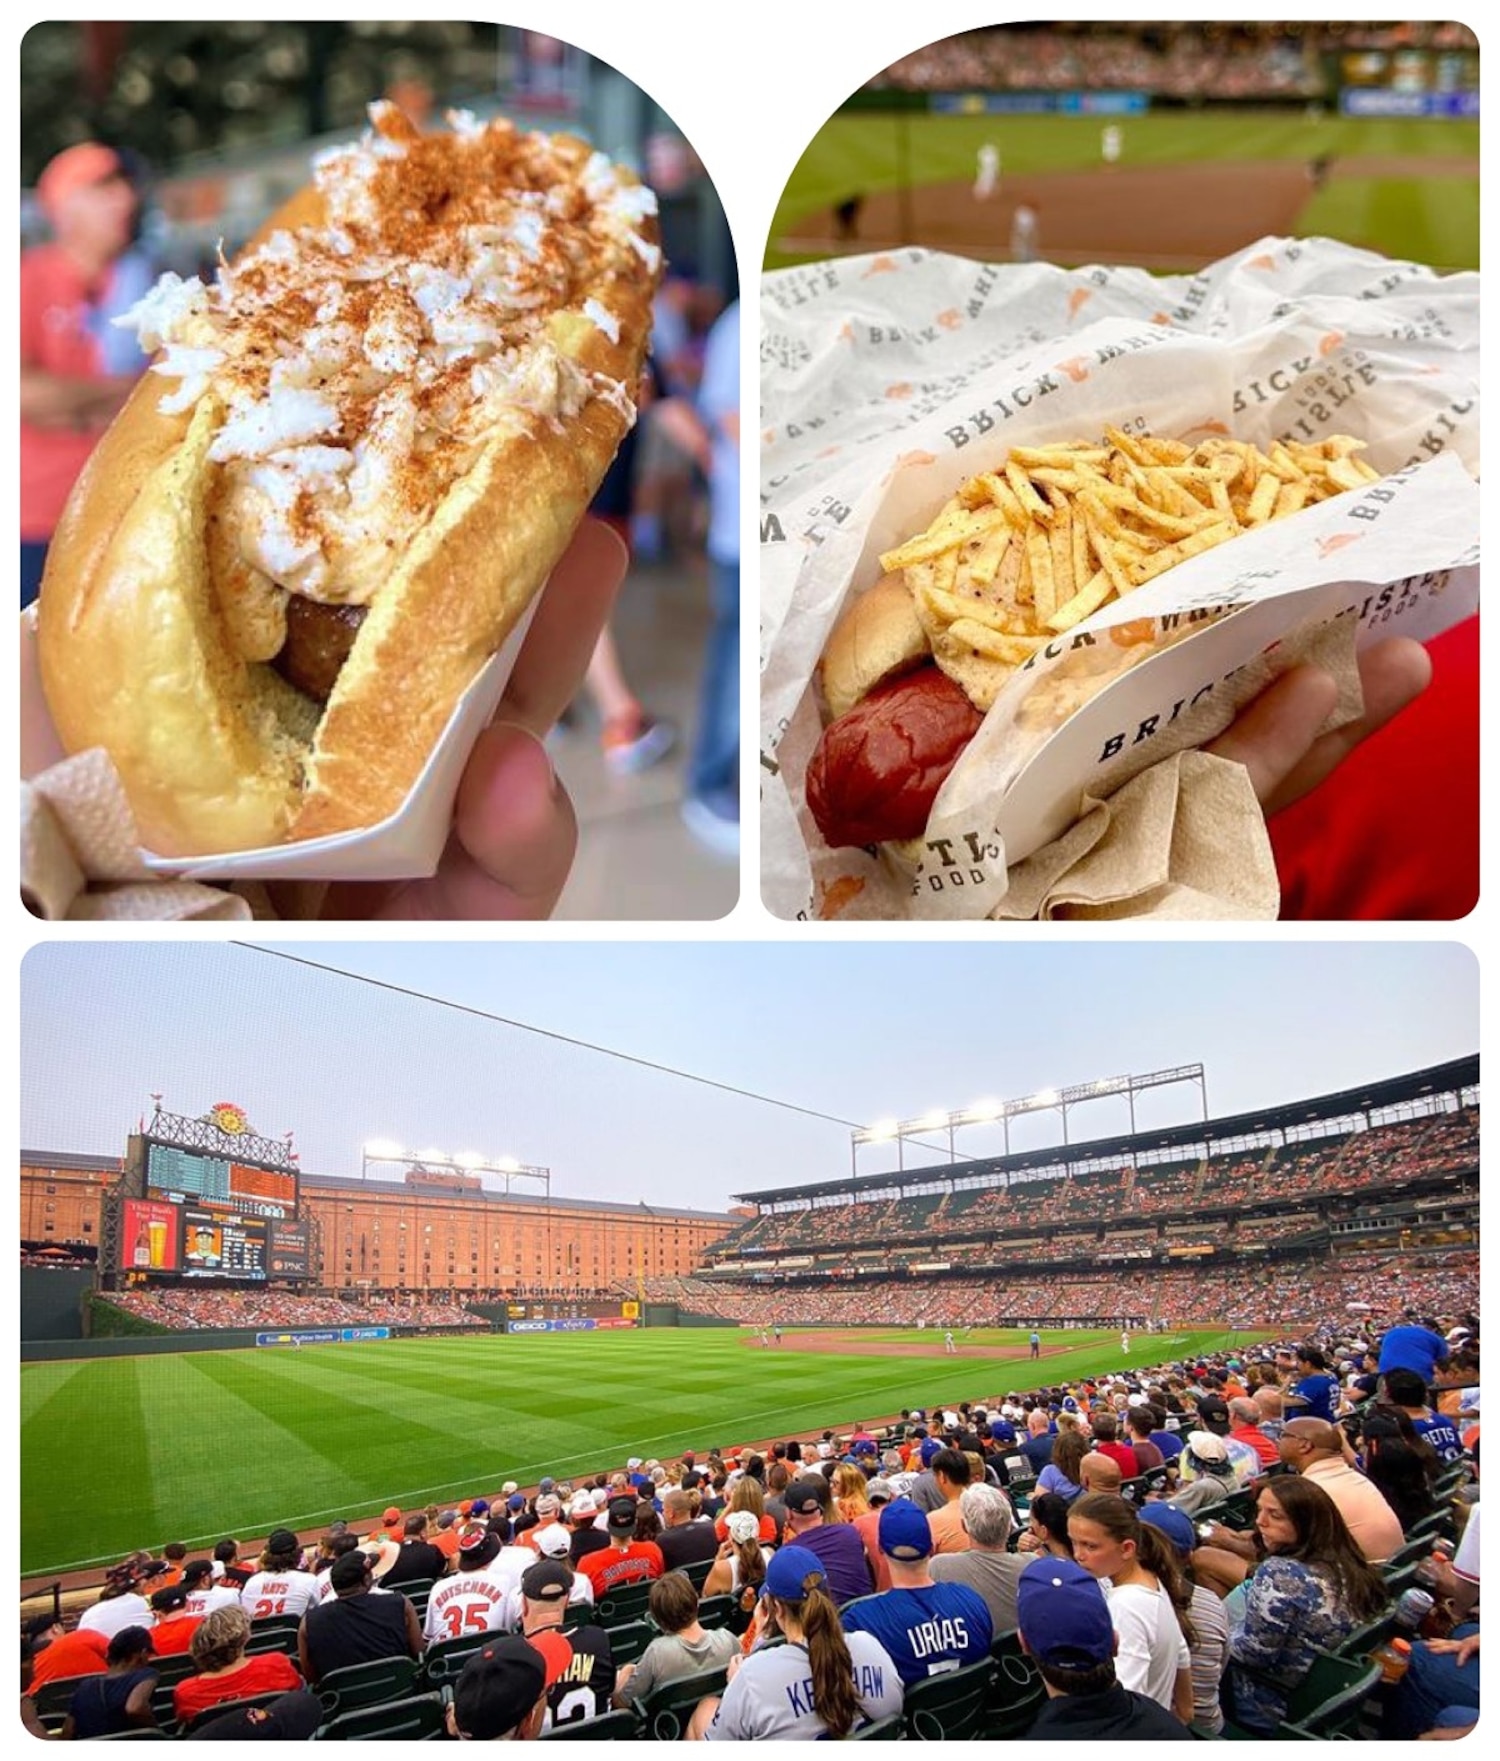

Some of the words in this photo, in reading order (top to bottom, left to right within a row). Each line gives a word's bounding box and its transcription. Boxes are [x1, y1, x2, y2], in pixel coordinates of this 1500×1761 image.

[283, 1261, 305, 1271] PNC
[435, 1581, 503, 1608] RUTSCHMAN
[443, 1602, 490, 1637] 35
[907, 1613, 968, 1658] URÍAS
